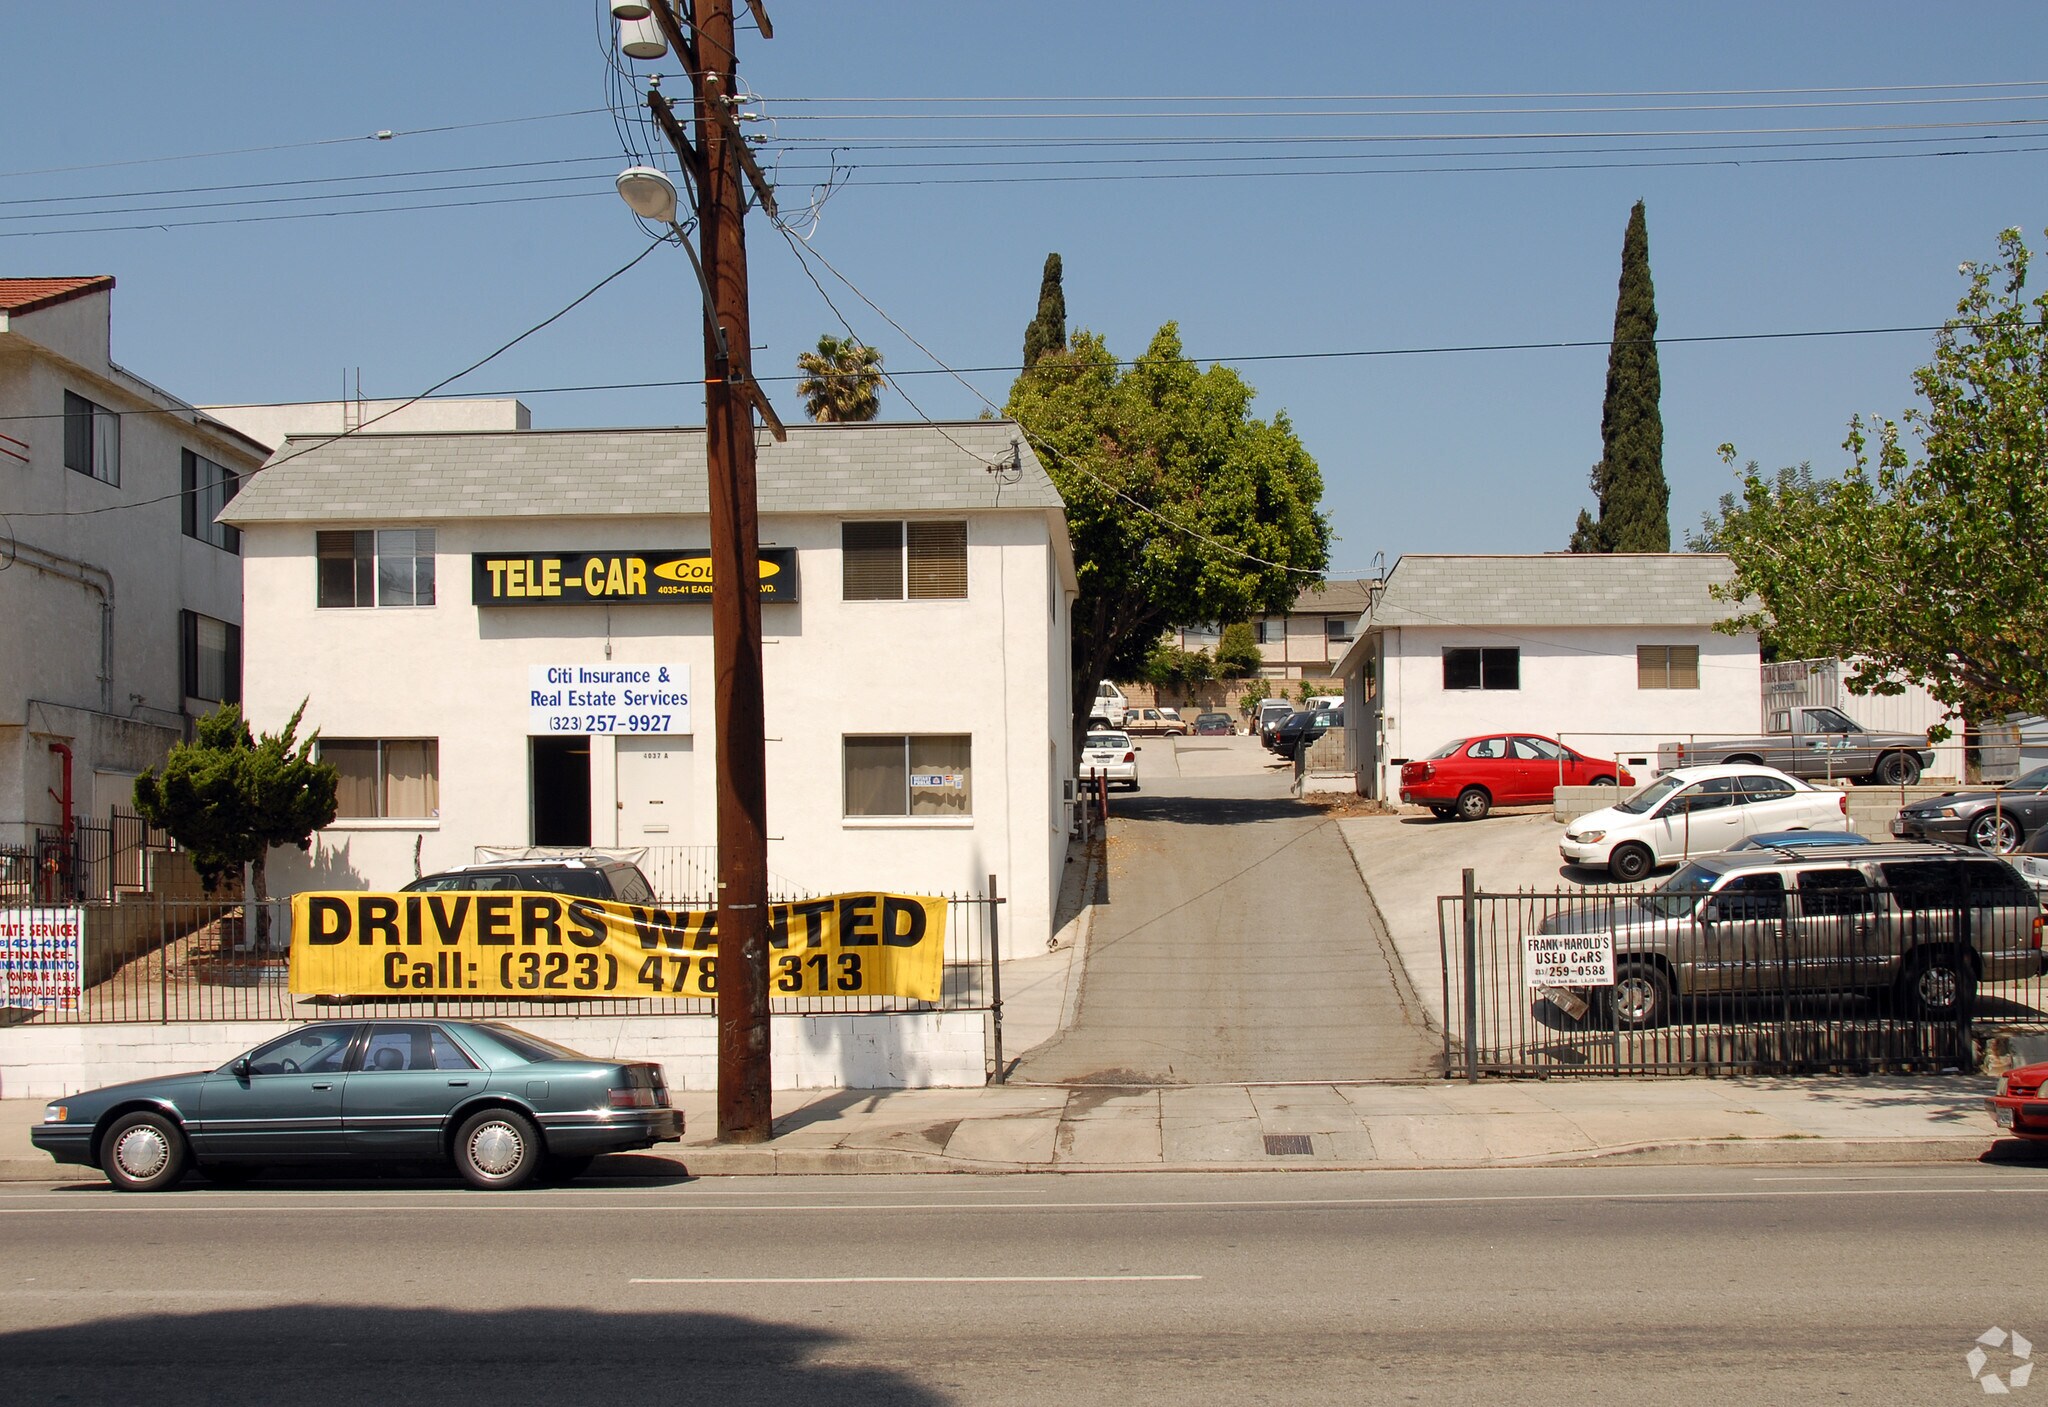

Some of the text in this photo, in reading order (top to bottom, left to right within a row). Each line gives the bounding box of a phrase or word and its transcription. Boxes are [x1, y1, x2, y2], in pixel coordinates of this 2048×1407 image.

[487, 557, 647, 597] TELE-CAR
[658, 584, 776, 594] 4035-41 EAGL VD.
[547, 667, 670, 684] Citi Insurance &
[530, 689, 688, 707] Real Estate Services
[549, 715, 672, 732] (323) 257-9927
[309, 896, 608, 947] DRIVERS
[1, 924, 79, 937] TATE SERVICES
[1528, 939, 1559, 951] FRANK
[1564, 937, 1609, 950] HAROLD'S
[0, 951, 73, 959] EFINANCE-
[1536, 951, 1602, 964] USED CARS
[0, 960, 80, 970] INANCIAMIENTOS
[384, 951, 862, 992] Call: (323) 478313
[6, 971, 38, 982] COMPRA
[9, 986, 81, 997] COMPRA DE CASAS
